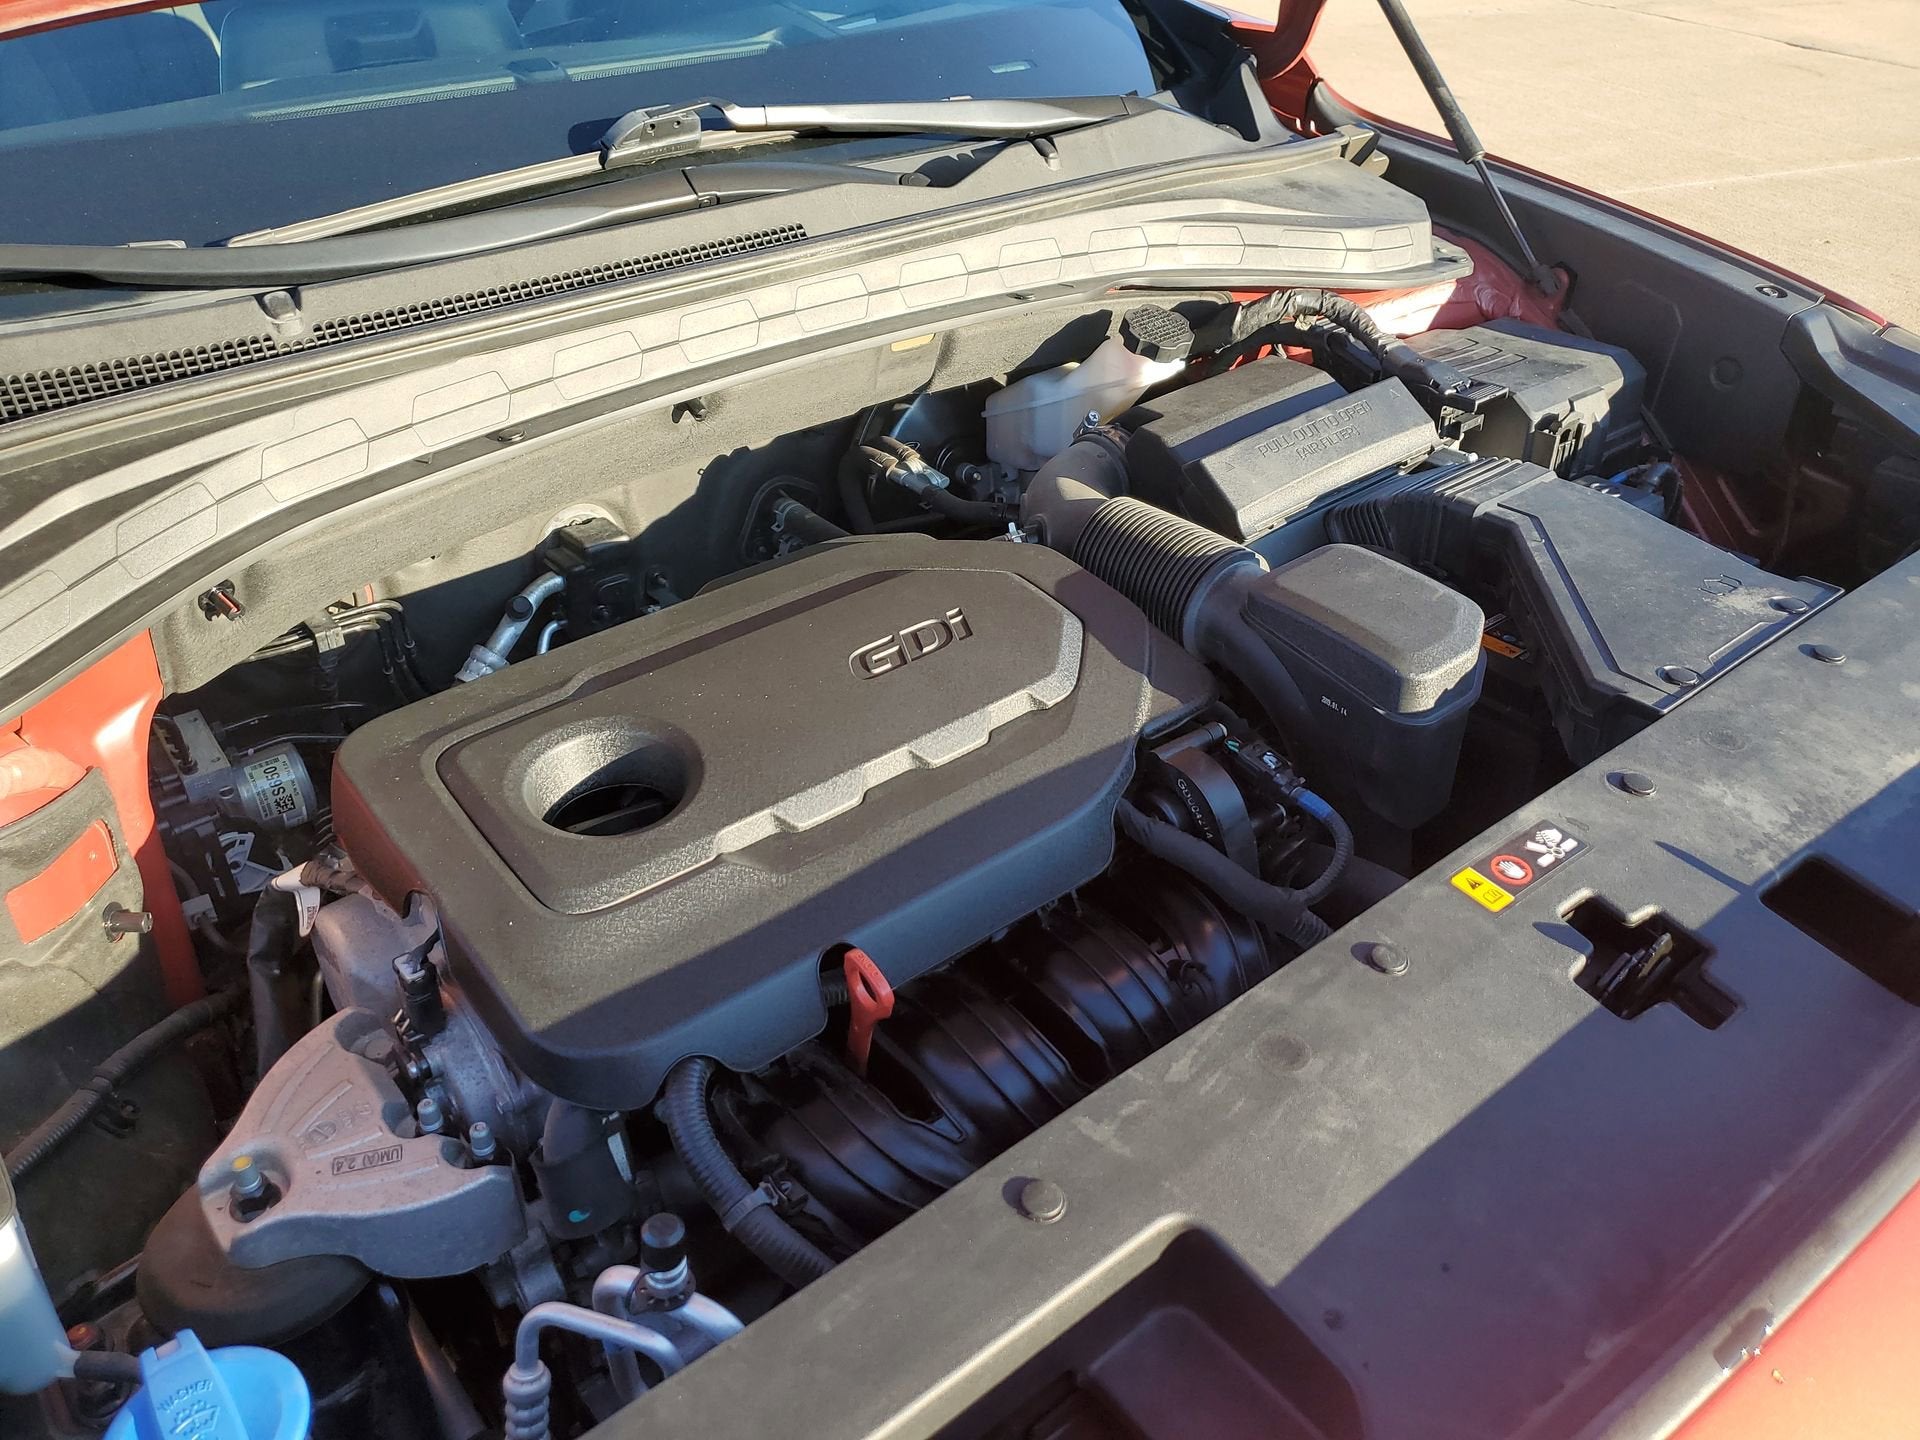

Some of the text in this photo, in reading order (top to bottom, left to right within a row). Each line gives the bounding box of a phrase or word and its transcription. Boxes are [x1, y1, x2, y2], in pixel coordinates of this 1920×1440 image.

[1257, 400, 1372, 457] PULL OUT TO OPEN
[848, 607, 974, 681] GDi
